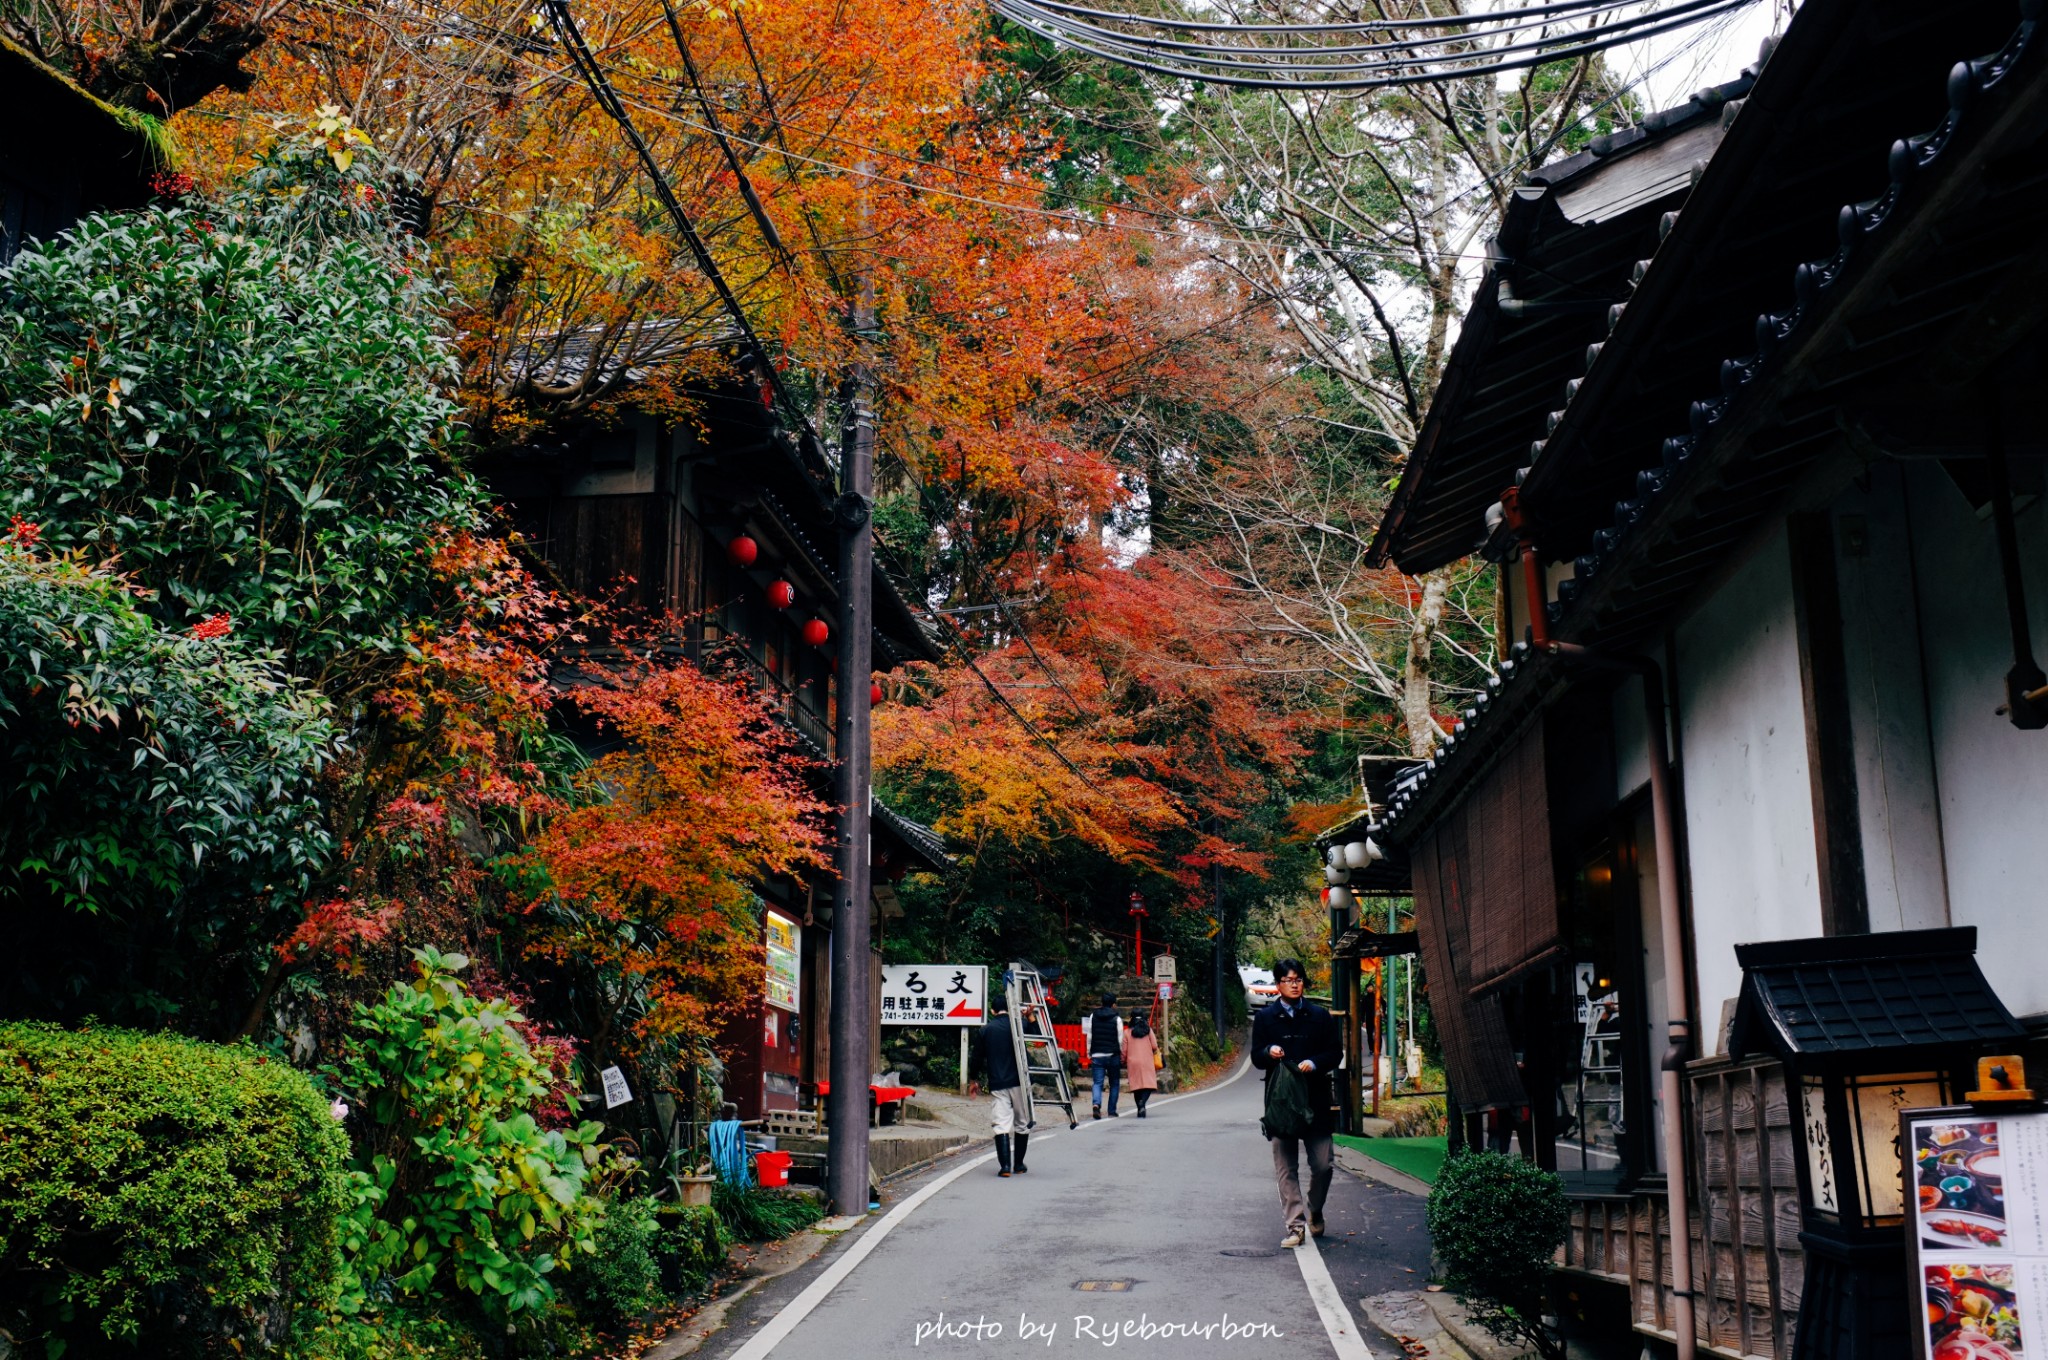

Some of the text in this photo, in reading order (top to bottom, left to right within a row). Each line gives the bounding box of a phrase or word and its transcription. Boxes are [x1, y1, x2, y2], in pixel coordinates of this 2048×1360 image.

[882, 971, 973, 994] ろ文
[882, 997, 946, 1011] 用駐車場
